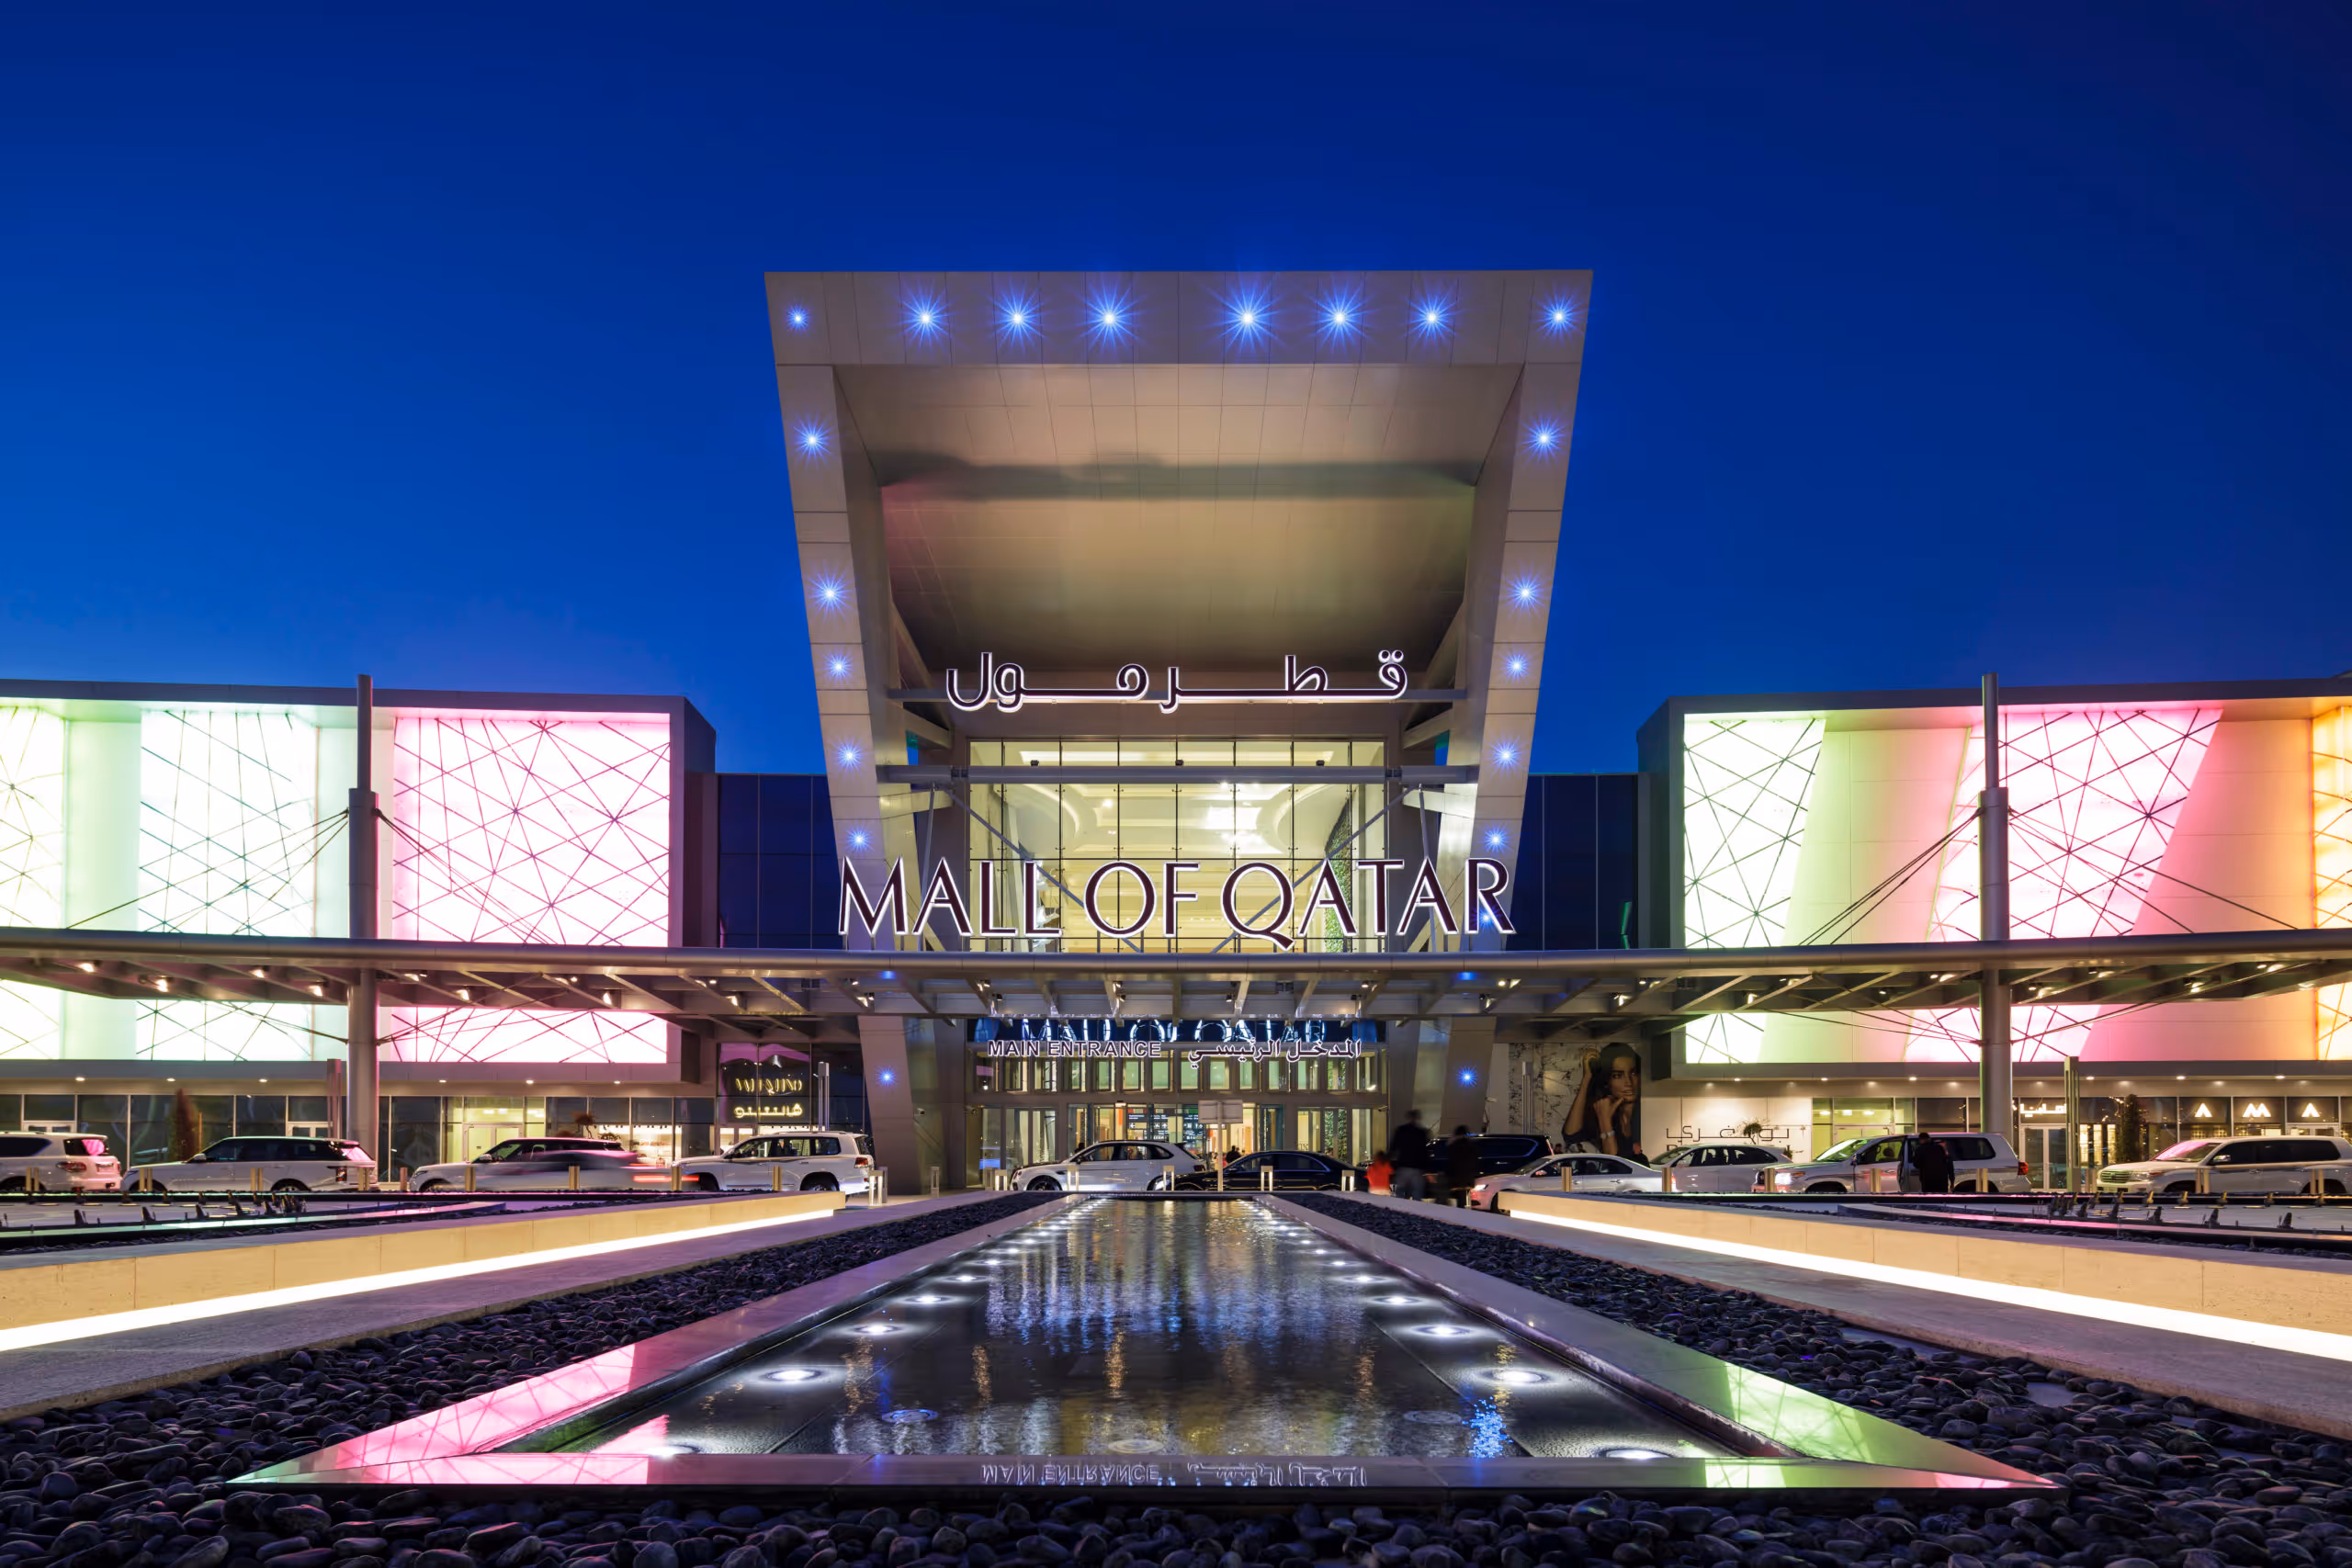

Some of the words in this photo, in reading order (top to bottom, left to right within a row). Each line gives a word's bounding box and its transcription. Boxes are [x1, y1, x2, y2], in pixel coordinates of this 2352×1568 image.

[837, 855, 1062, 938] MALL
[1083, 859, 1202, 939] OF
[1221, 856, 1516, 952] QATAR
[988, 1040, 1040, 1057] MAIN
[1047, 1040, 1162, 1058] ENTRANCE
[1188, 1036, 1282, 1069] الرئيسي
[1286, 1038, 1362, 1064] المدخل
